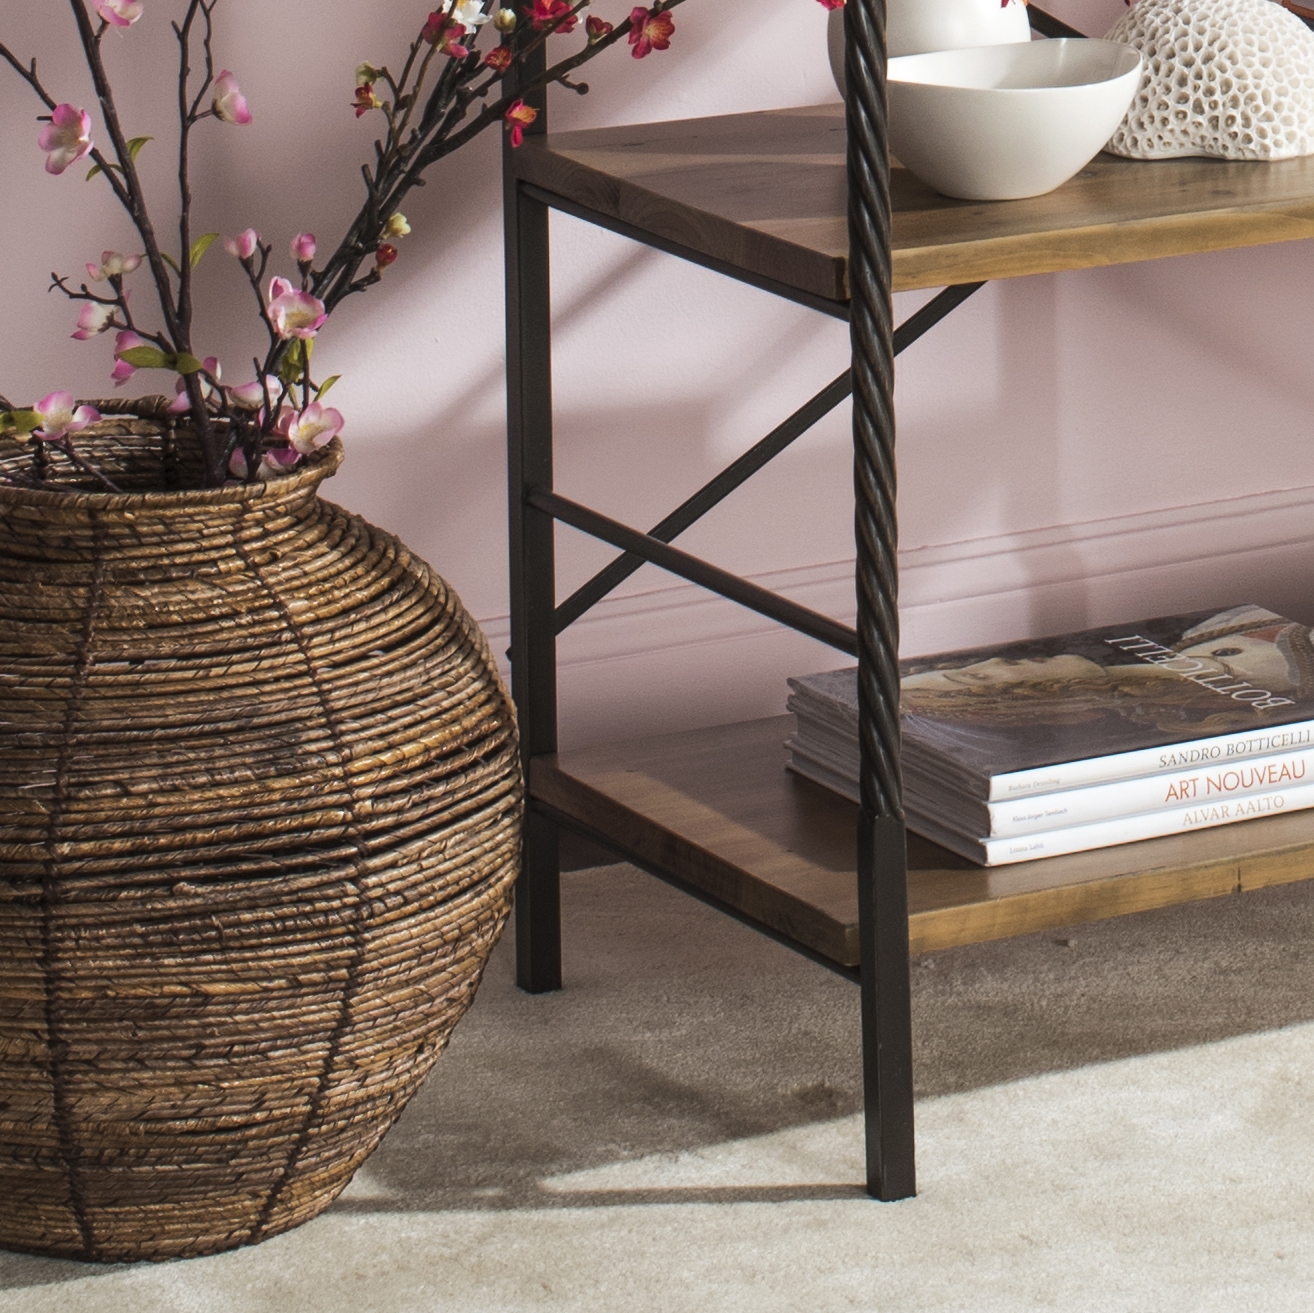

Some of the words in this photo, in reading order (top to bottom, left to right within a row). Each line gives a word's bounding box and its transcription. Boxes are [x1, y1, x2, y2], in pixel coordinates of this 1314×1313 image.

[1104, 634, 1296, 710] BOTTICELLI
[1159, 745, 1221, 768] SANDRO
[1226, 729, 1311, 756] BOTTICELLI
[1165, 777, 1200, 803] ART
[1206, 759, 1306, 795] NOUVEAU
[1182, 805, 1231, 826] ALVAR
[1235, 795, 1285, 817] AALTO
